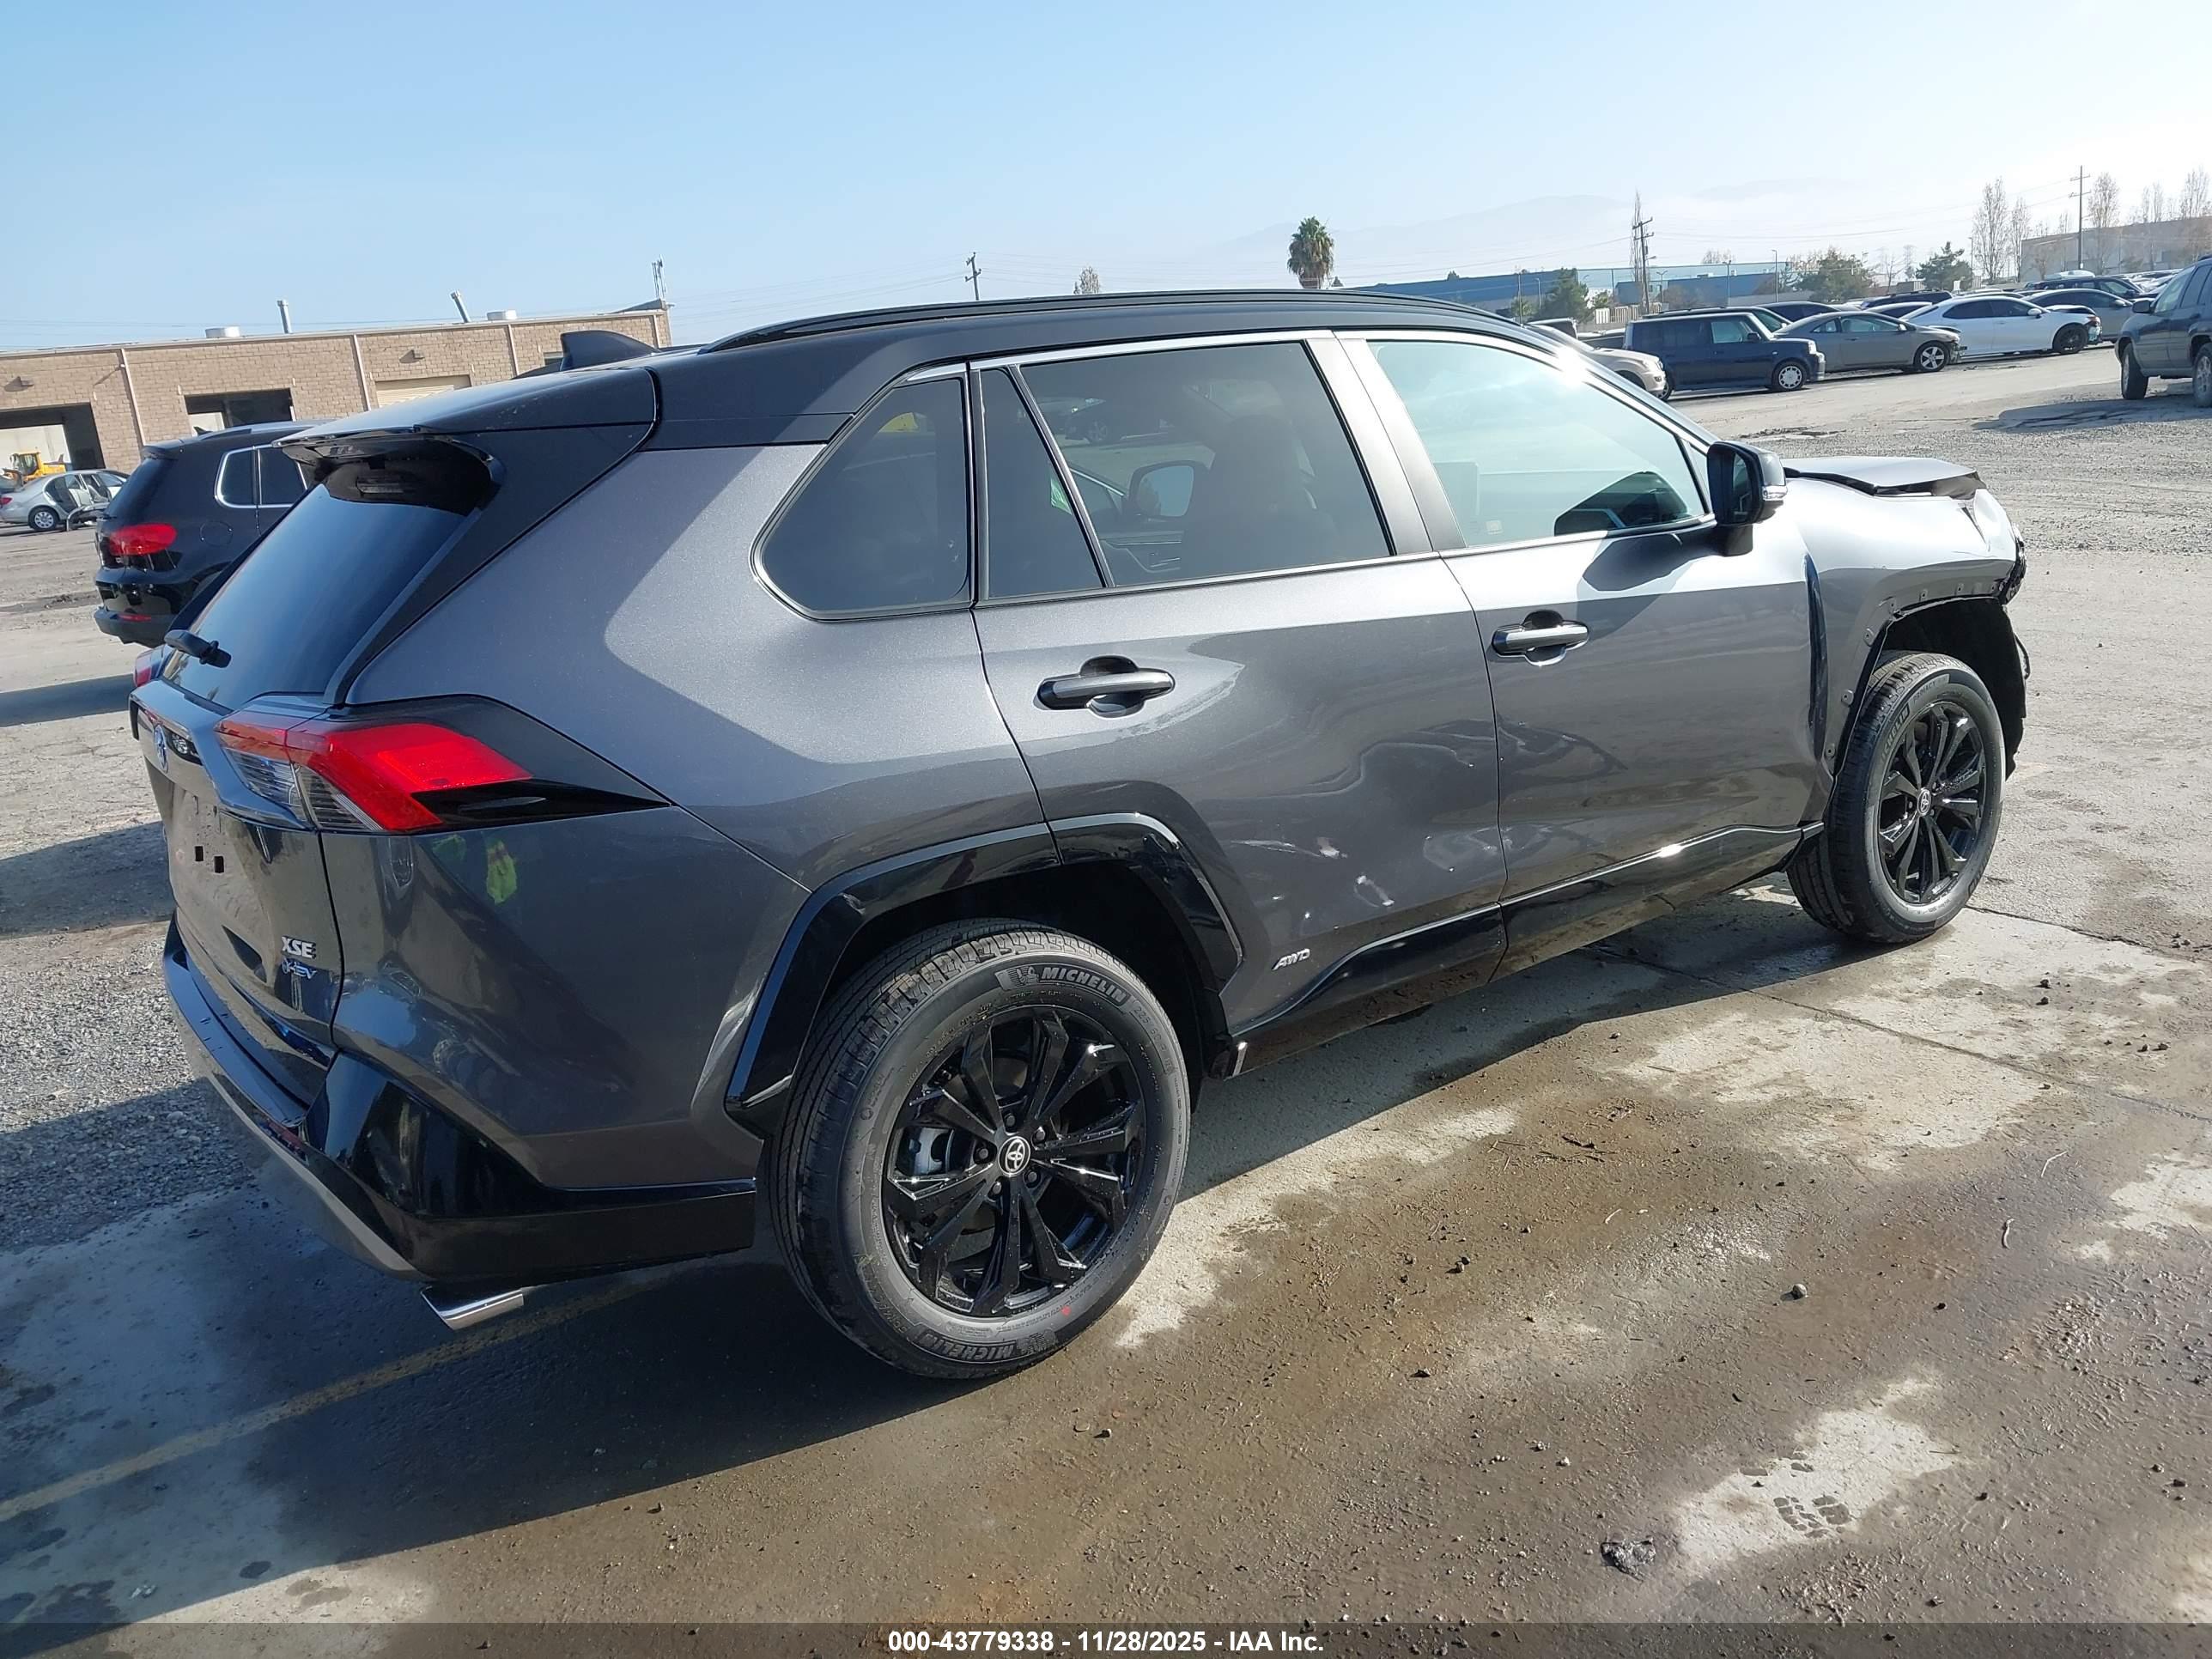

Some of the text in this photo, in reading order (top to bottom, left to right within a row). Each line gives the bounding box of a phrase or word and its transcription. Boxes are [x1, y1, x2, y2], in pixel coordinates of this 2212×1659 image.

[281, 936, 316, 958] XSE
[1272, 948, 1310, 971] AWD
[1041, 967, 1127, 1003] MICHELIN
[921, 1332, 1015, 1360] MICHELIN
